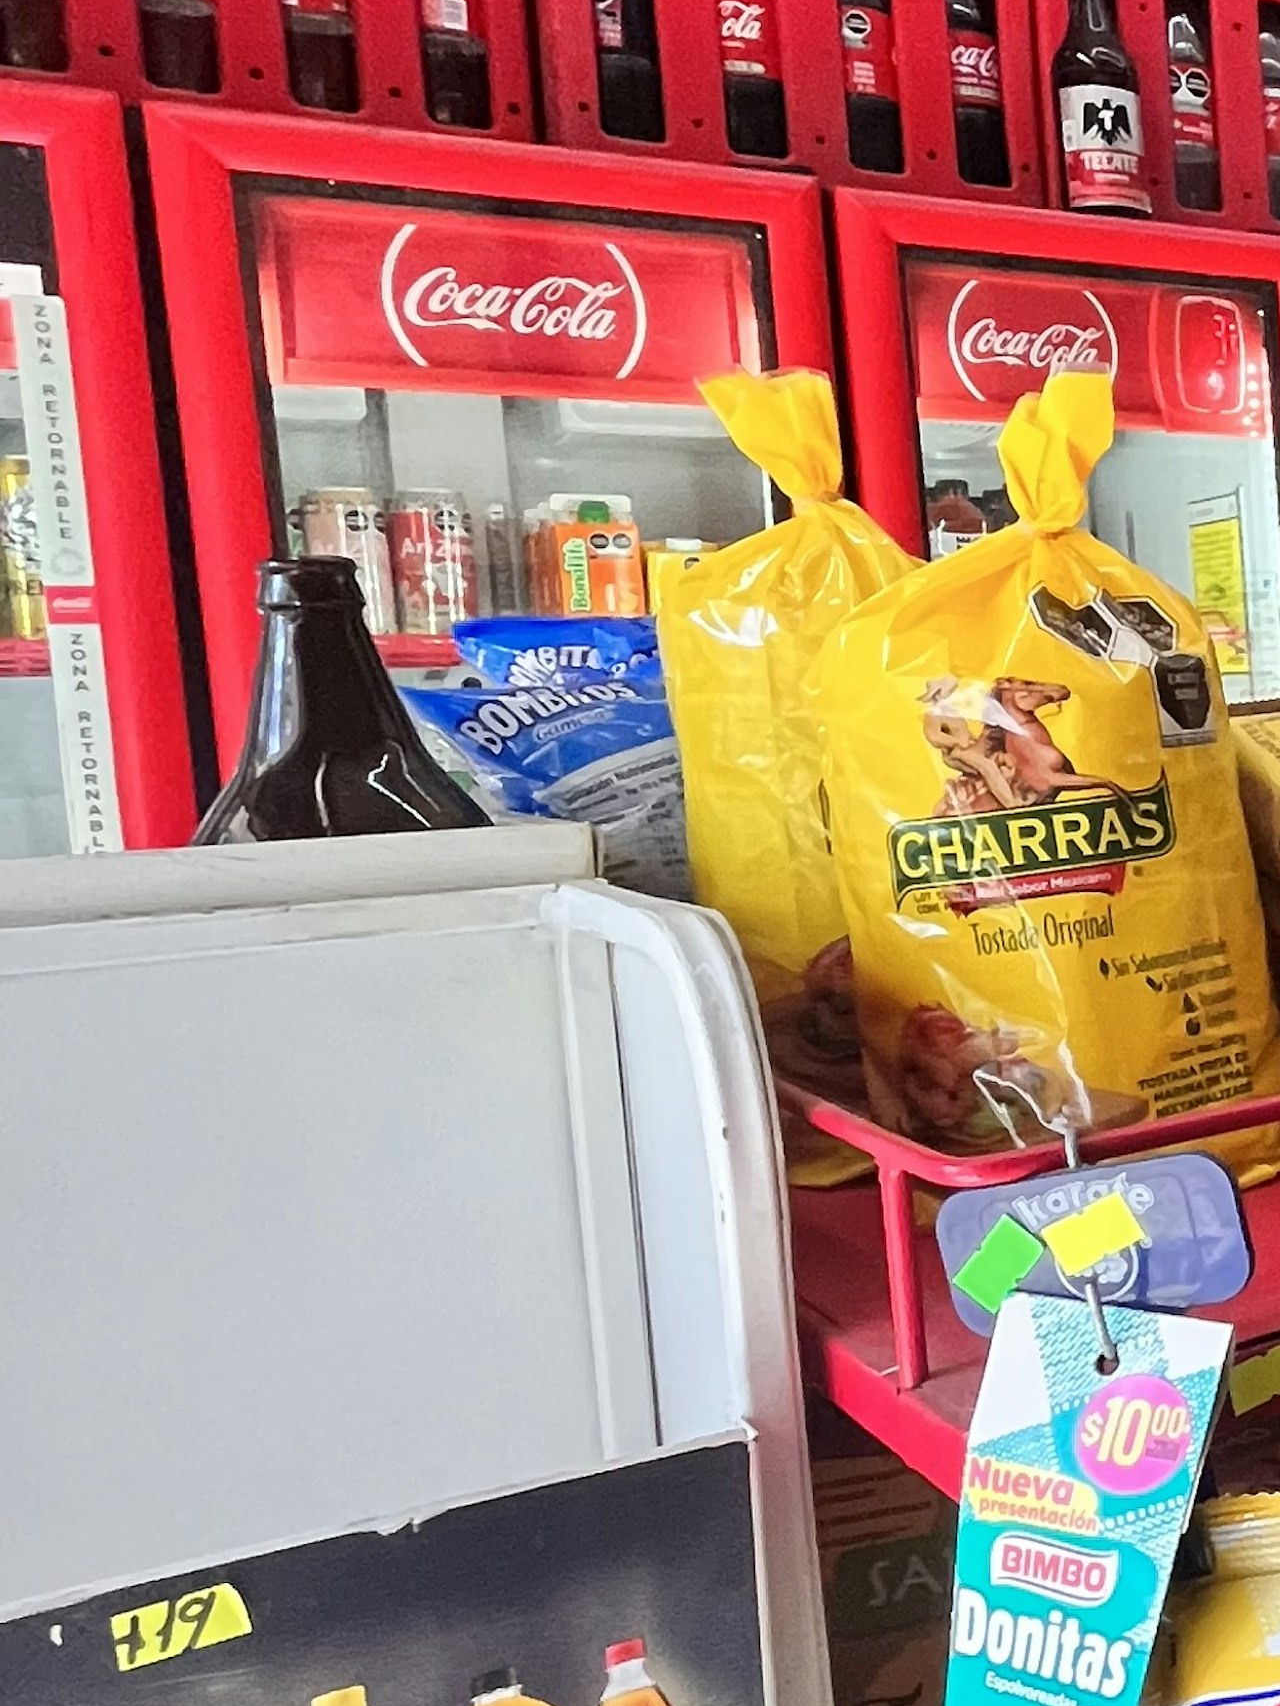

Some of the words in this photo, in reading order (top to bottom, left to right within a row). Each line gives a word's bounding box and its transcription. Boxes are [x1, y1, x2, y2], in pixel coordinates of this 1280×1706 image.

[1079, 149, 1140, 175] TECATE
[403, 265, 625, 342] Coca-Cola
[33, 304, 56, 366] ZONA
[41, 383, 73, 541] RETORNABLE
[69, 631, 90, 694] ZONA
[76, 709, 109, 852] RETORNABL
[895, 799, 1169, 881] CHARRAS
[968, 919, 1039, 959] Tostada
[1041, 905, 1115, 952] Original
[968, 1459, 1075, 1508] Nueva
[978, 1495, 1098, 1535] presentación
[1001, 1545, 1108, 1595] BIMBO
[954, 1589, 1134, 1699] Donitas
